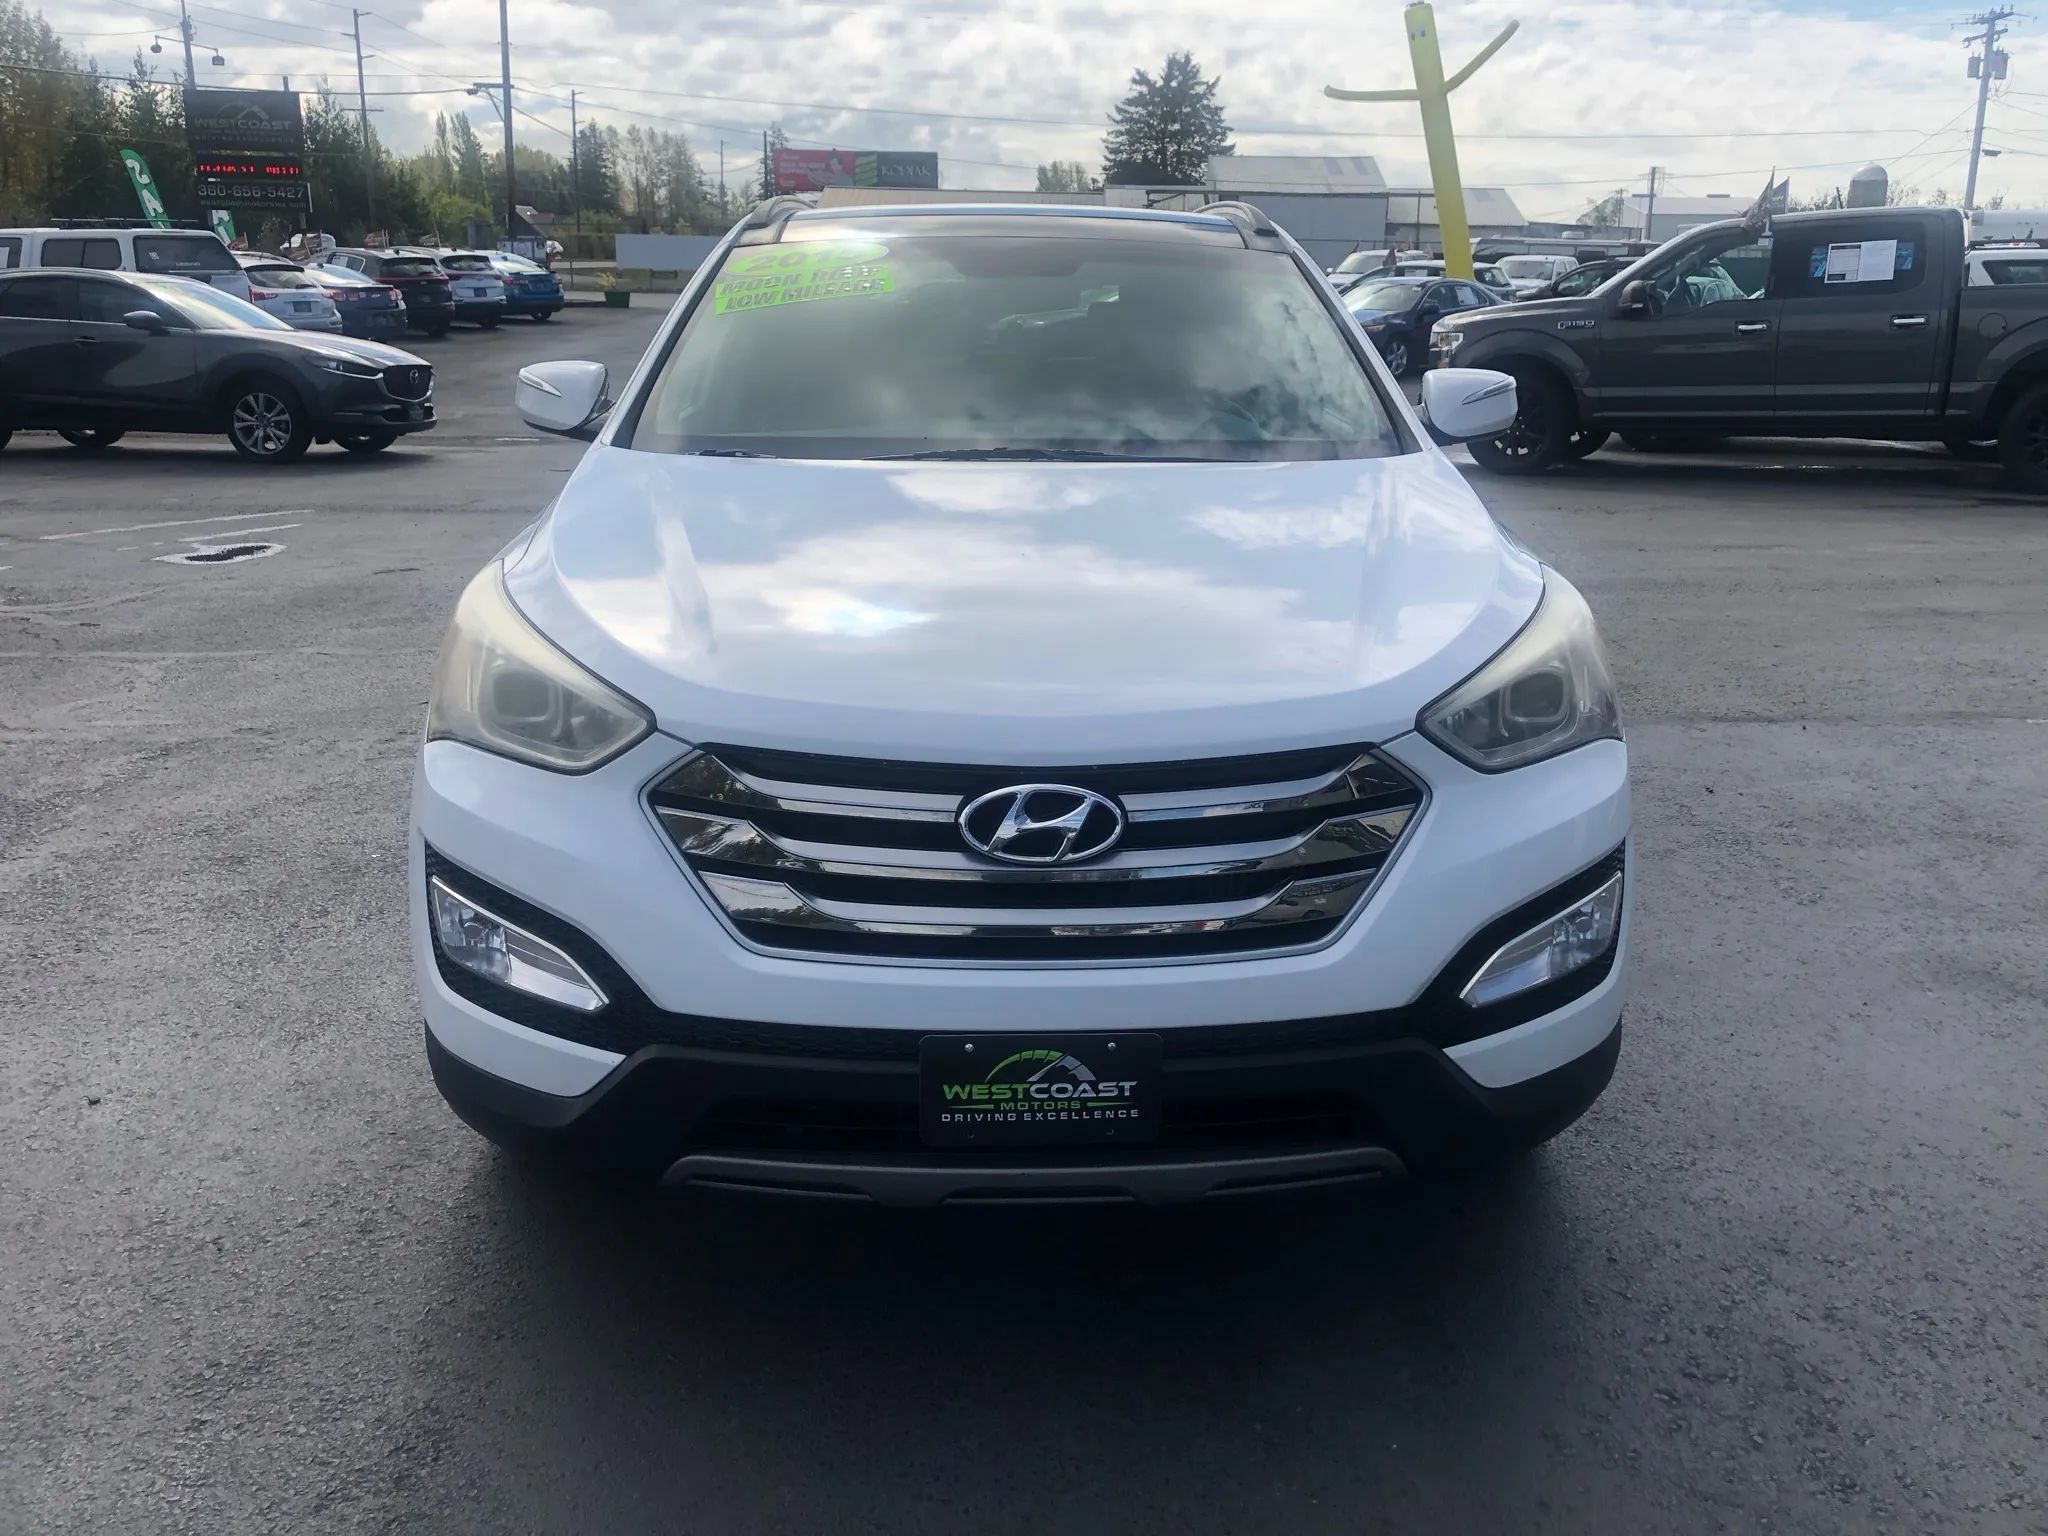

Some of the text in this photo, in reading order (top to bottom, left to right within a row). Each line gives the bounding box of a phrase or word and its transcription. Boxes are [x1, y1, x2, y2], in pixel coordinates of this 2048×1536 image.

[198, 185, 305, 198] 360-656-5427
[725, 290, 778, 310] LOW
[942, 1080, 1137, 1100] WESTCOAST
[1000, 1101, 1080, 1111] MOTORS
[941, 1109, 1139, 1122] DRIVING EXCELLENCE
